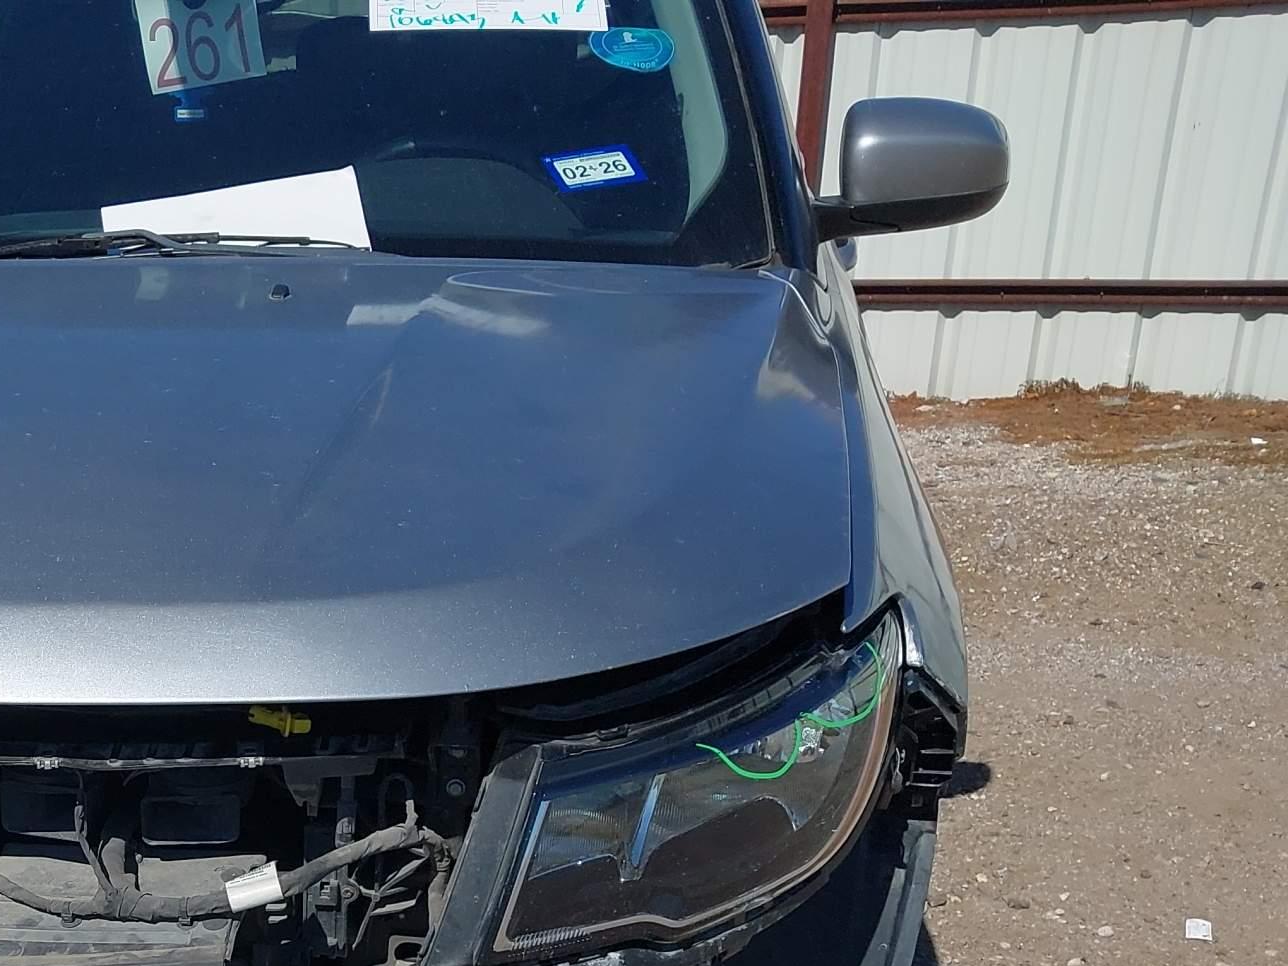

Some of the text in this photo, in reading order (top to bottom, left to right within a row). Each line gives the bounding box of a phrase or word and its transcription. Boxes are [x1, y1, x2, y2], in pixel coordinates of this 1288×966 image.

[149, 3, 251, 89] 261
[562, 159, 627, 180] 02 26
